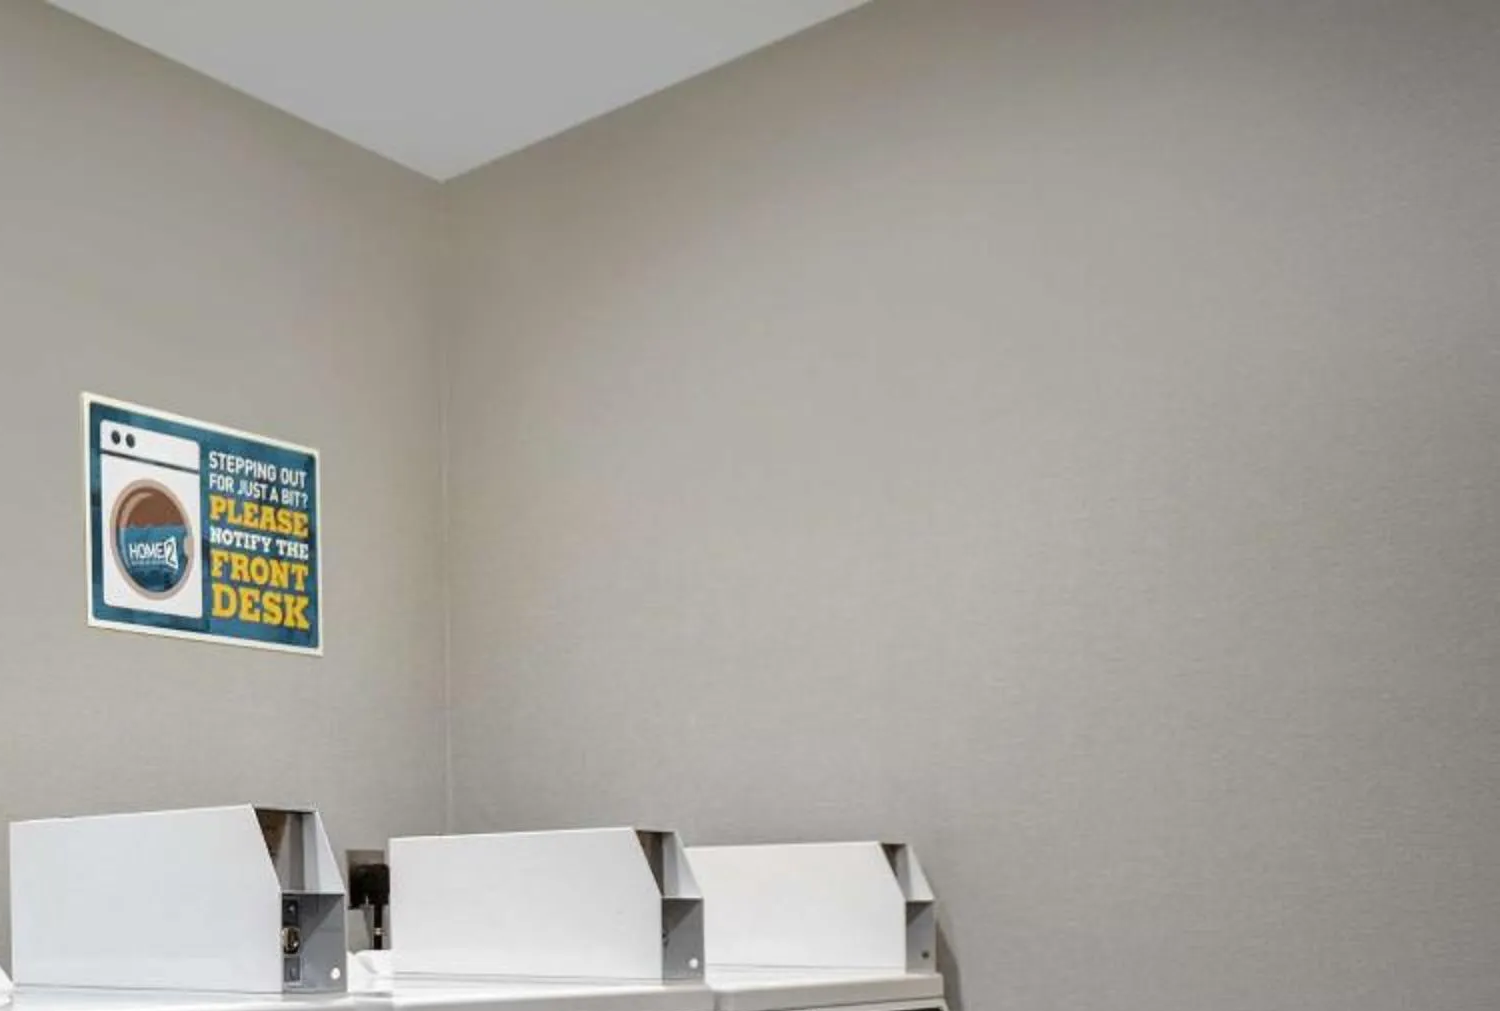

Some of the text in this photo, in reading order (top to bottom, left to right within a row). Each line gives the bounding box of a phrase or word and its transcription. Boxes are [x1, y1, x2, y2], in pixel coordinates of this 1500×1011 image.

[209, 450, 307, 489] STEPPING OUT
[209, 473, 308, 509] FOR JUST A BIT?
[209, 495, 309, 539] PLEASE
[209, 526, 309, 560] NOTIFY THE
[210, 549, 309, 592] FRONT
[211, 582, 310, 631] DESK
